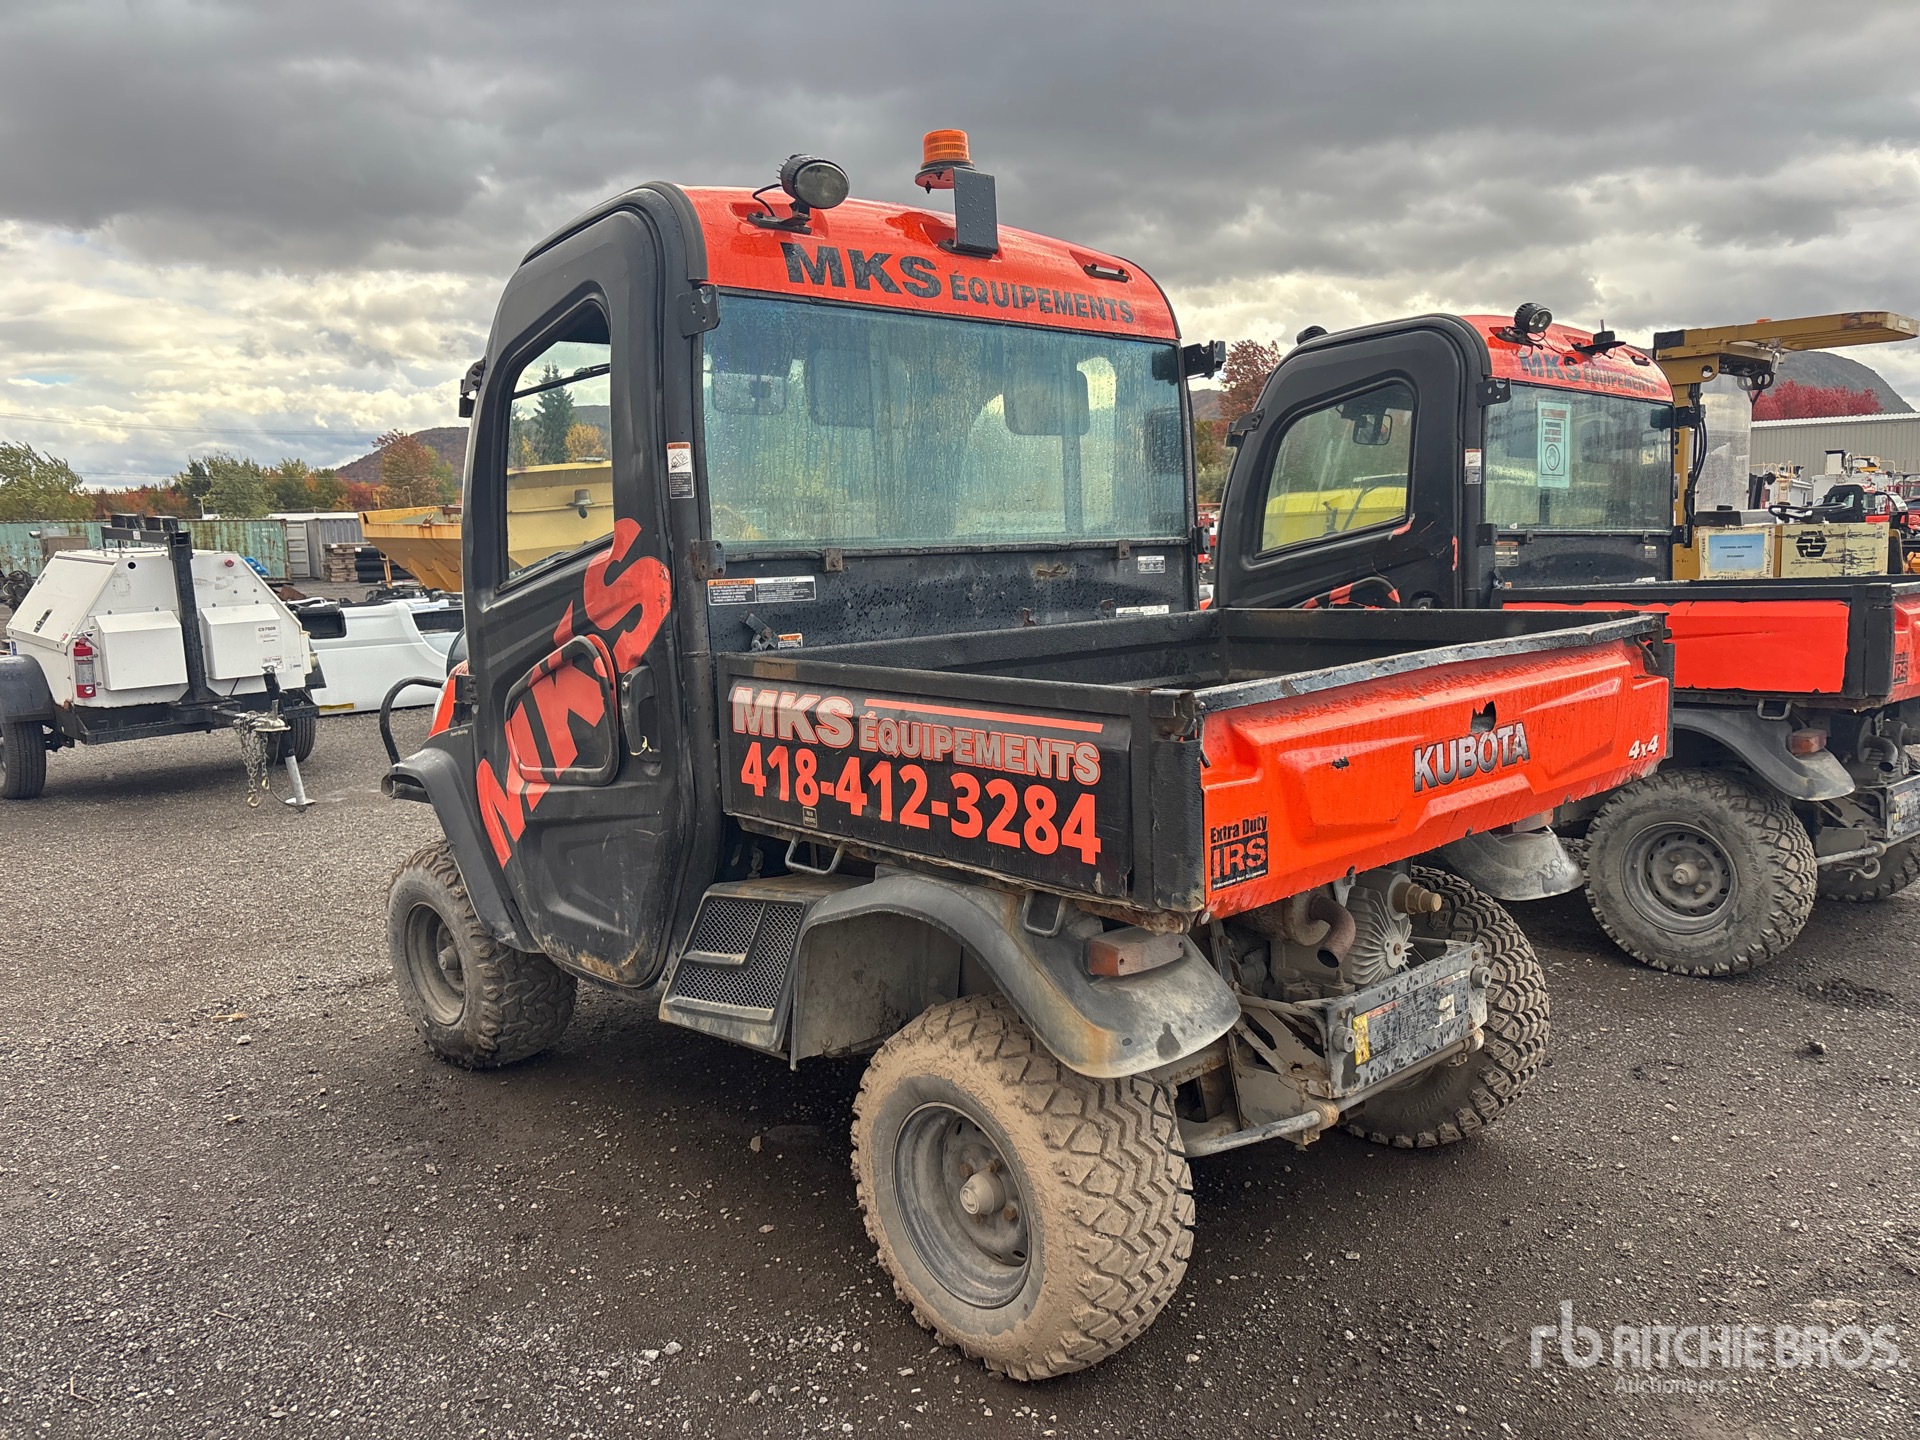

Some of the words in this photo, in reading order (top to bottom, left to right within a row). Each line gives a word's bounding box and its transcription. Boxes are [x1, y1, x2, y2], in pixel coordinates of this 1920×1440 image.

[780, 242, 942, 298] MKS
[951, 270, 1135, 324] ÉQUIPEMENTS
[1518, 351, 1582, 382] MKS
[731, 686, 855, 749] MKS
[858, 711, 1102, 786] ÉQUIPEMENTS
[1413, 722, 1531, 793] KUBOTA
[1627, 735, 1660, 760] 4x4
[741, 741, 1102, 865] 418-412-3284
[1210, 823, 1240, 844] Extra
[1242, 816, 1268, 835] Duty
[1213, 837, 1267, 879] IRS
